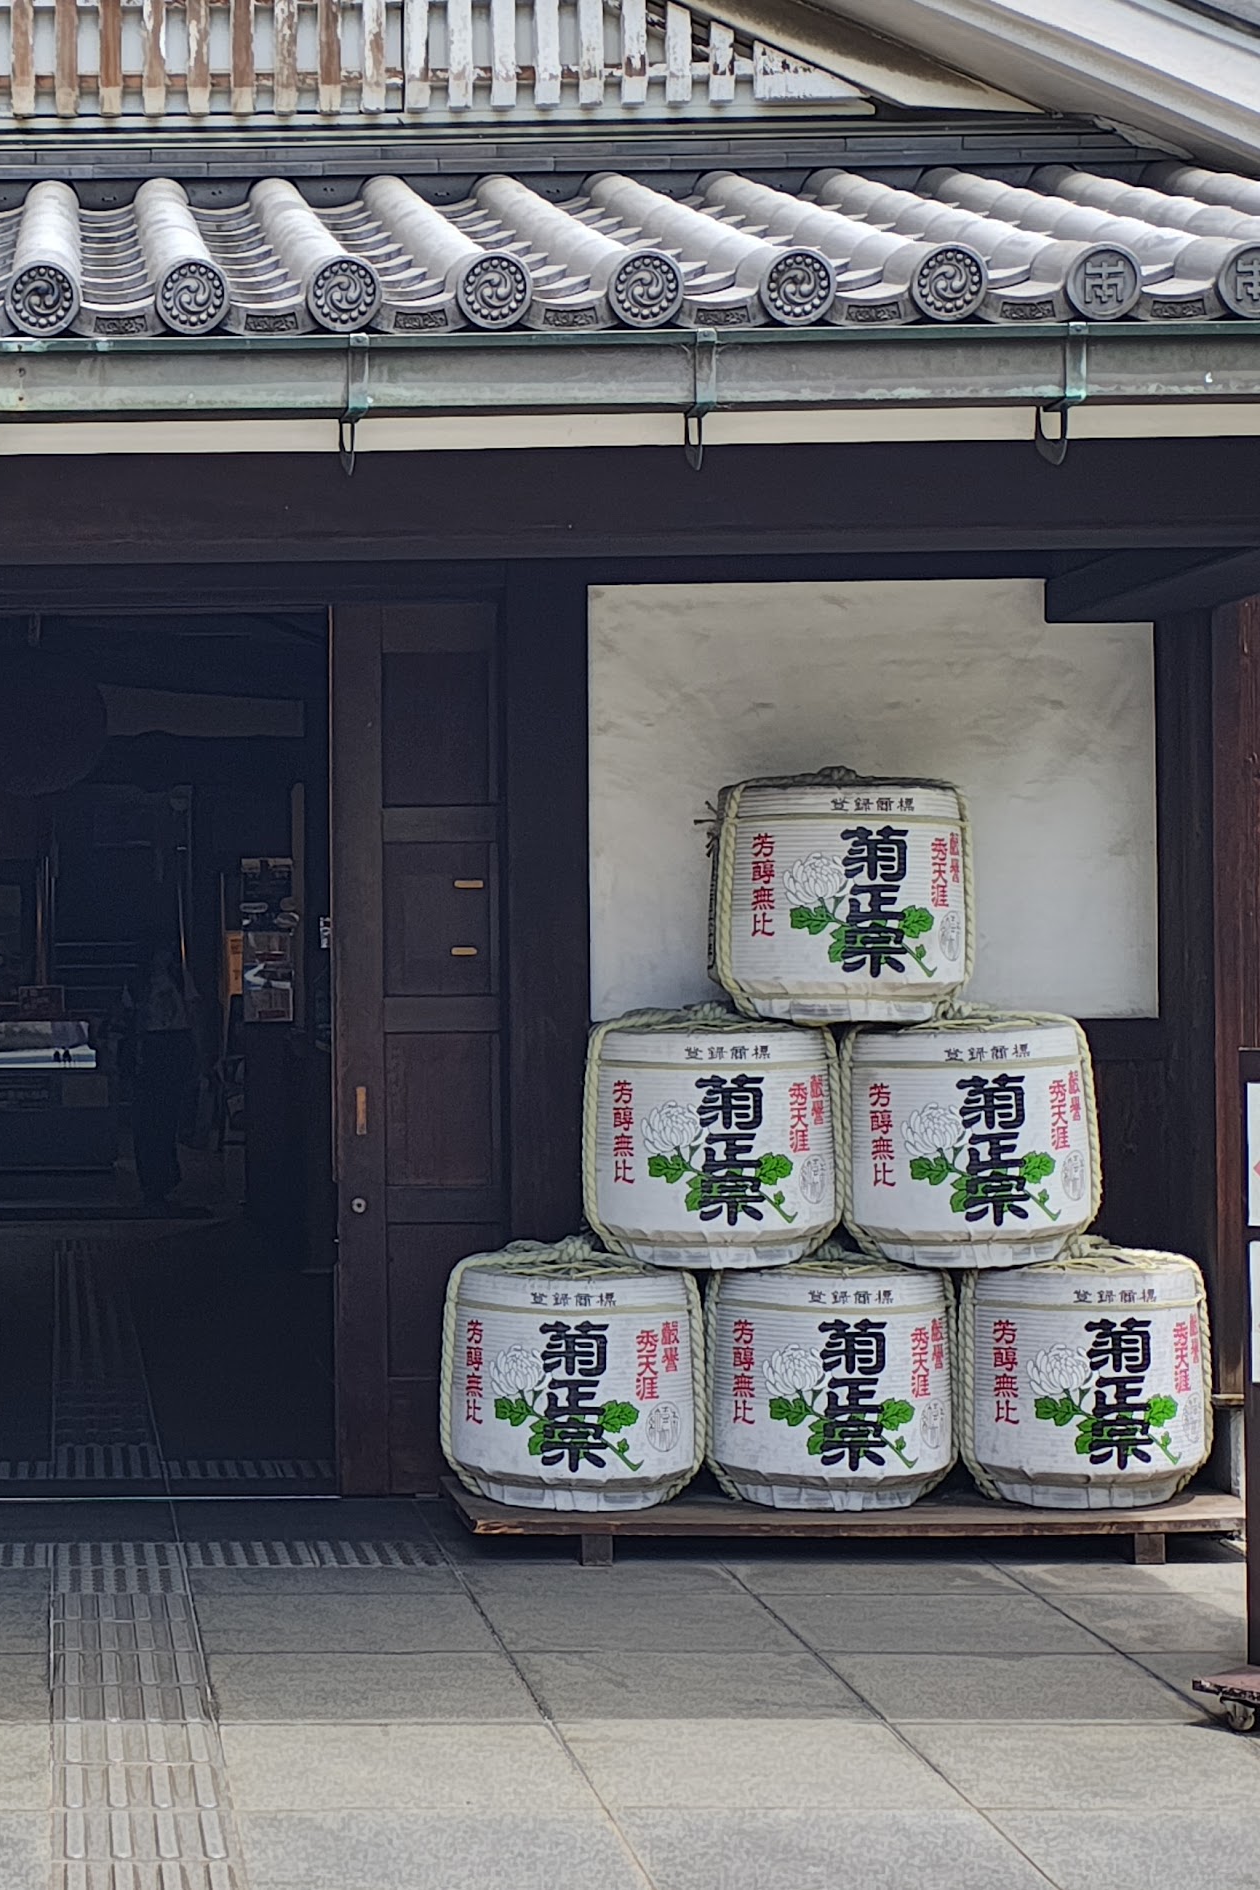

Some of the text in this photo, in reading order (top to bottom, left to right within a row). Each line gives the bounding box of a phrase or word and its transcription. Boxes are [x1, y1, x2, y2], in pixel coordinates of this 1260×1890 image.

[751, 833, 775, 937] 芳醇無比
[840, 825, 909, 978] 菊正宗
[613, 1080, 635, 1184] 芳醇無比
[695, 1073, 765, 1226] 菊正宗
[869, 1082, 896, 1188] 芳醇無比
[956, 1073, 1031, 1226] 菊正宗
[465, 1319, 484, 1425] 芳醇無比
[539, 1320, 610, 1473] 菊正宗
[732, 1319, 755, 1425] 芳醇無比
[818, 1318, 887, 1472] 菊正宗
[992, 1319, 1020, 1425] 芳醇無比
[1085, 1317, 1154, 1471] 菊正宗
